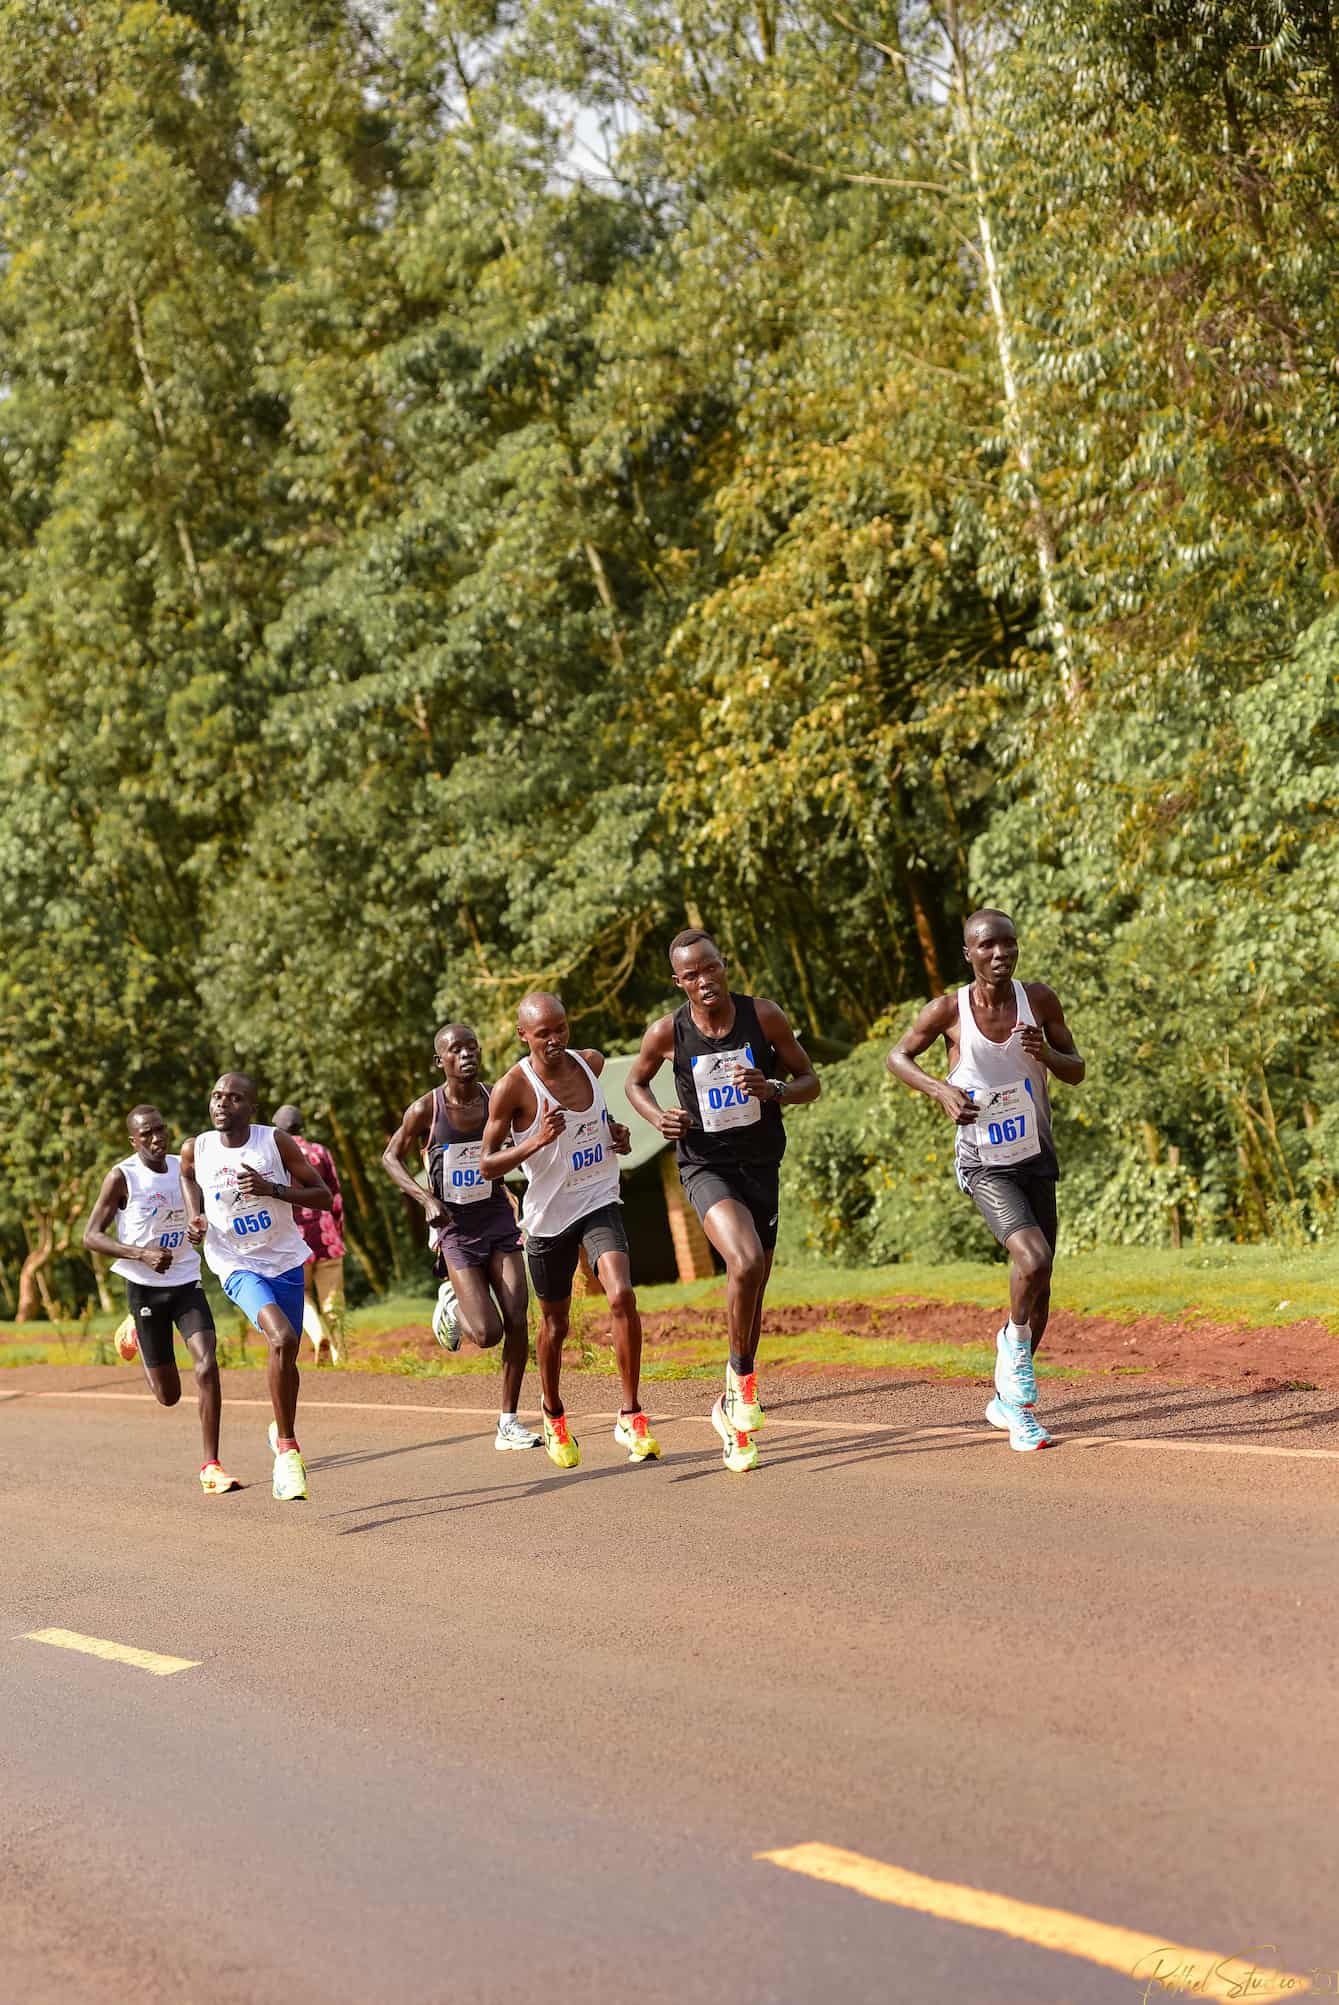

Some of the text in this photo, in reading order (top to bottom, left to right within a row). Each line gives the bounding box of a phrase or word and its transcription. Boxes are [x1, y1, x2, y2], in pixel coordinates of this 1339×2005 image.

[988, 1115, 1025, 1145] 067
[572, 1143, 603, 1171] 050
[233, 1210, 272, 1236] 056
[160, 1231, 185, 1248] 037
